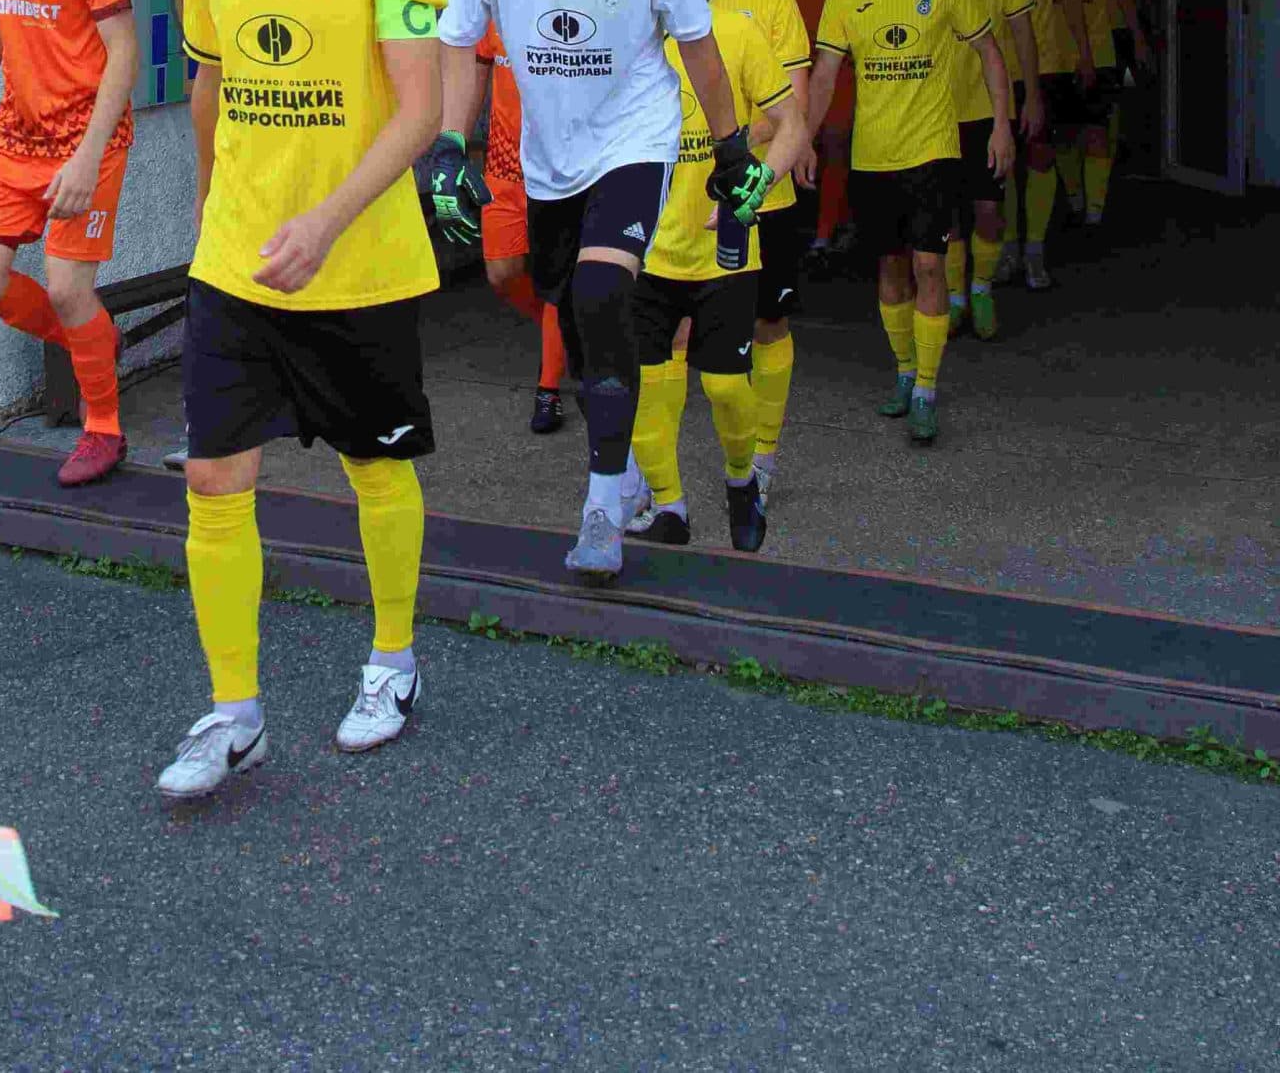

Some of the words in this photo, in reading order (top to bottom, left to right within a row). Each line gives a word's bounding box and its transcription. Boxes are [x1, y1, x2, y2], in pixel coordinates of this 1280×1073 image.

[526, 51, 613, 67] КУЗНЕЦКИЕ
[864, 59, 934, 72] КУЗНЕЦКИЕ
[528, 65, 613, 78] ФЕРРОСПЛАВЫ
[223, 87, 344, 111] КУЗНЕЦКИЕ
[86, 210, 107, 239] 27
